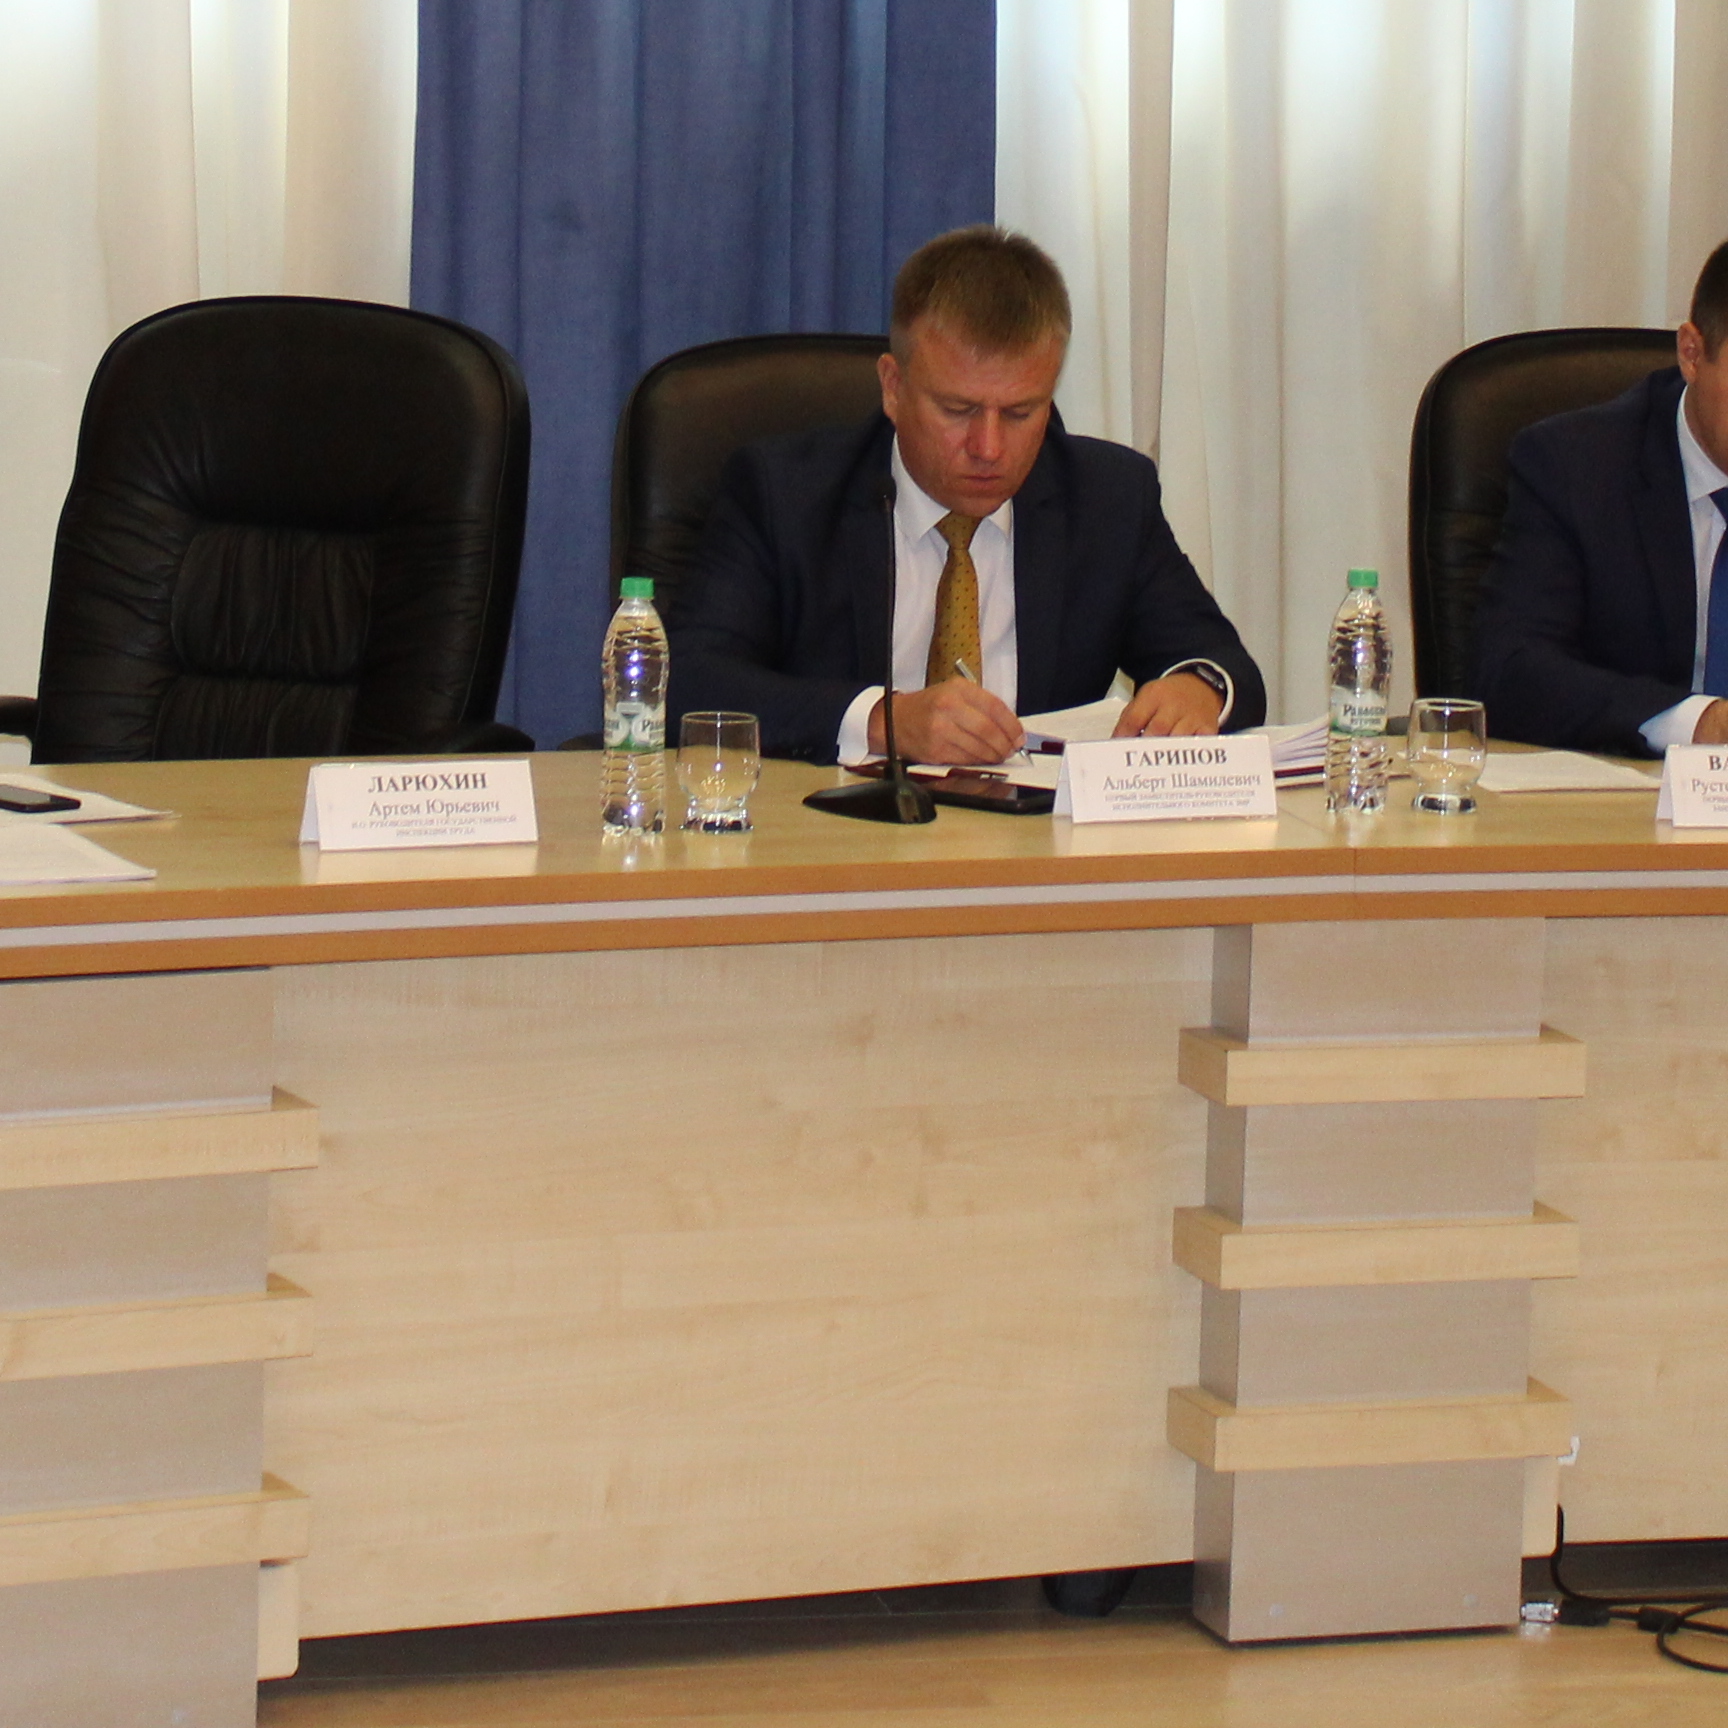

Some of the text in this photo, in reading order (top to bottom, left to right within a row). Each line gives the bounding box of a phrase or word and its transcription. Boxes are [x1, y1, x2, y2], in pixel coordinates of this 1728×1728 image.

[1125, 749, 1227, 767] ГАРИПОВ
[368, 773, 487, 793] ЛАРЮХИН
[1103, 773, 1261, 793] Альберт Шамилевич
[425, 798, 500, 817] Юрьевич
